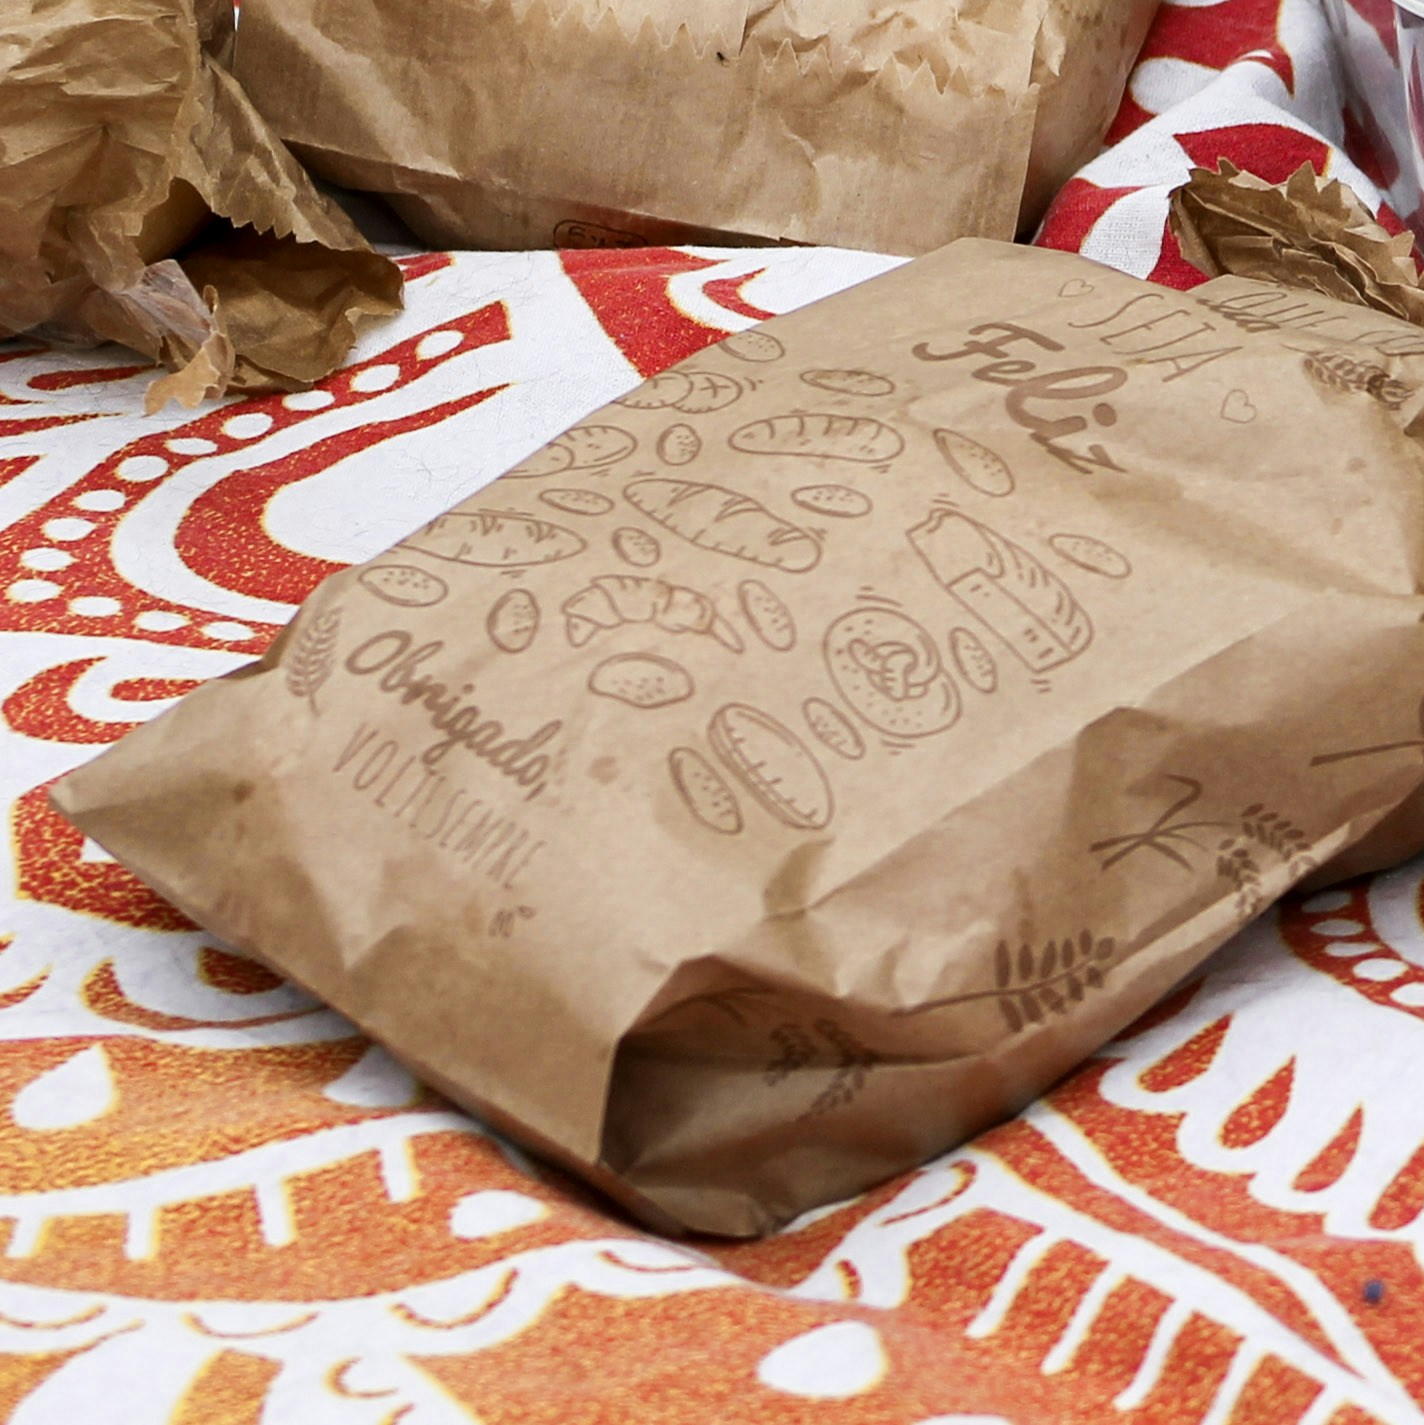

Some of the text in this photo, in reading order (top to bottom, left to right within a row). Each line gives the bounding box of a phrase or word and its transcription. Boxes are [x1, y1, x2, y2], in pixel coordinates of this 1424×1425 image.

[911, 321, 1131, 479] Feliz
[1069, 287, 1242, 385] SEJA
[345, 629, 566, 802] Obrigado,
